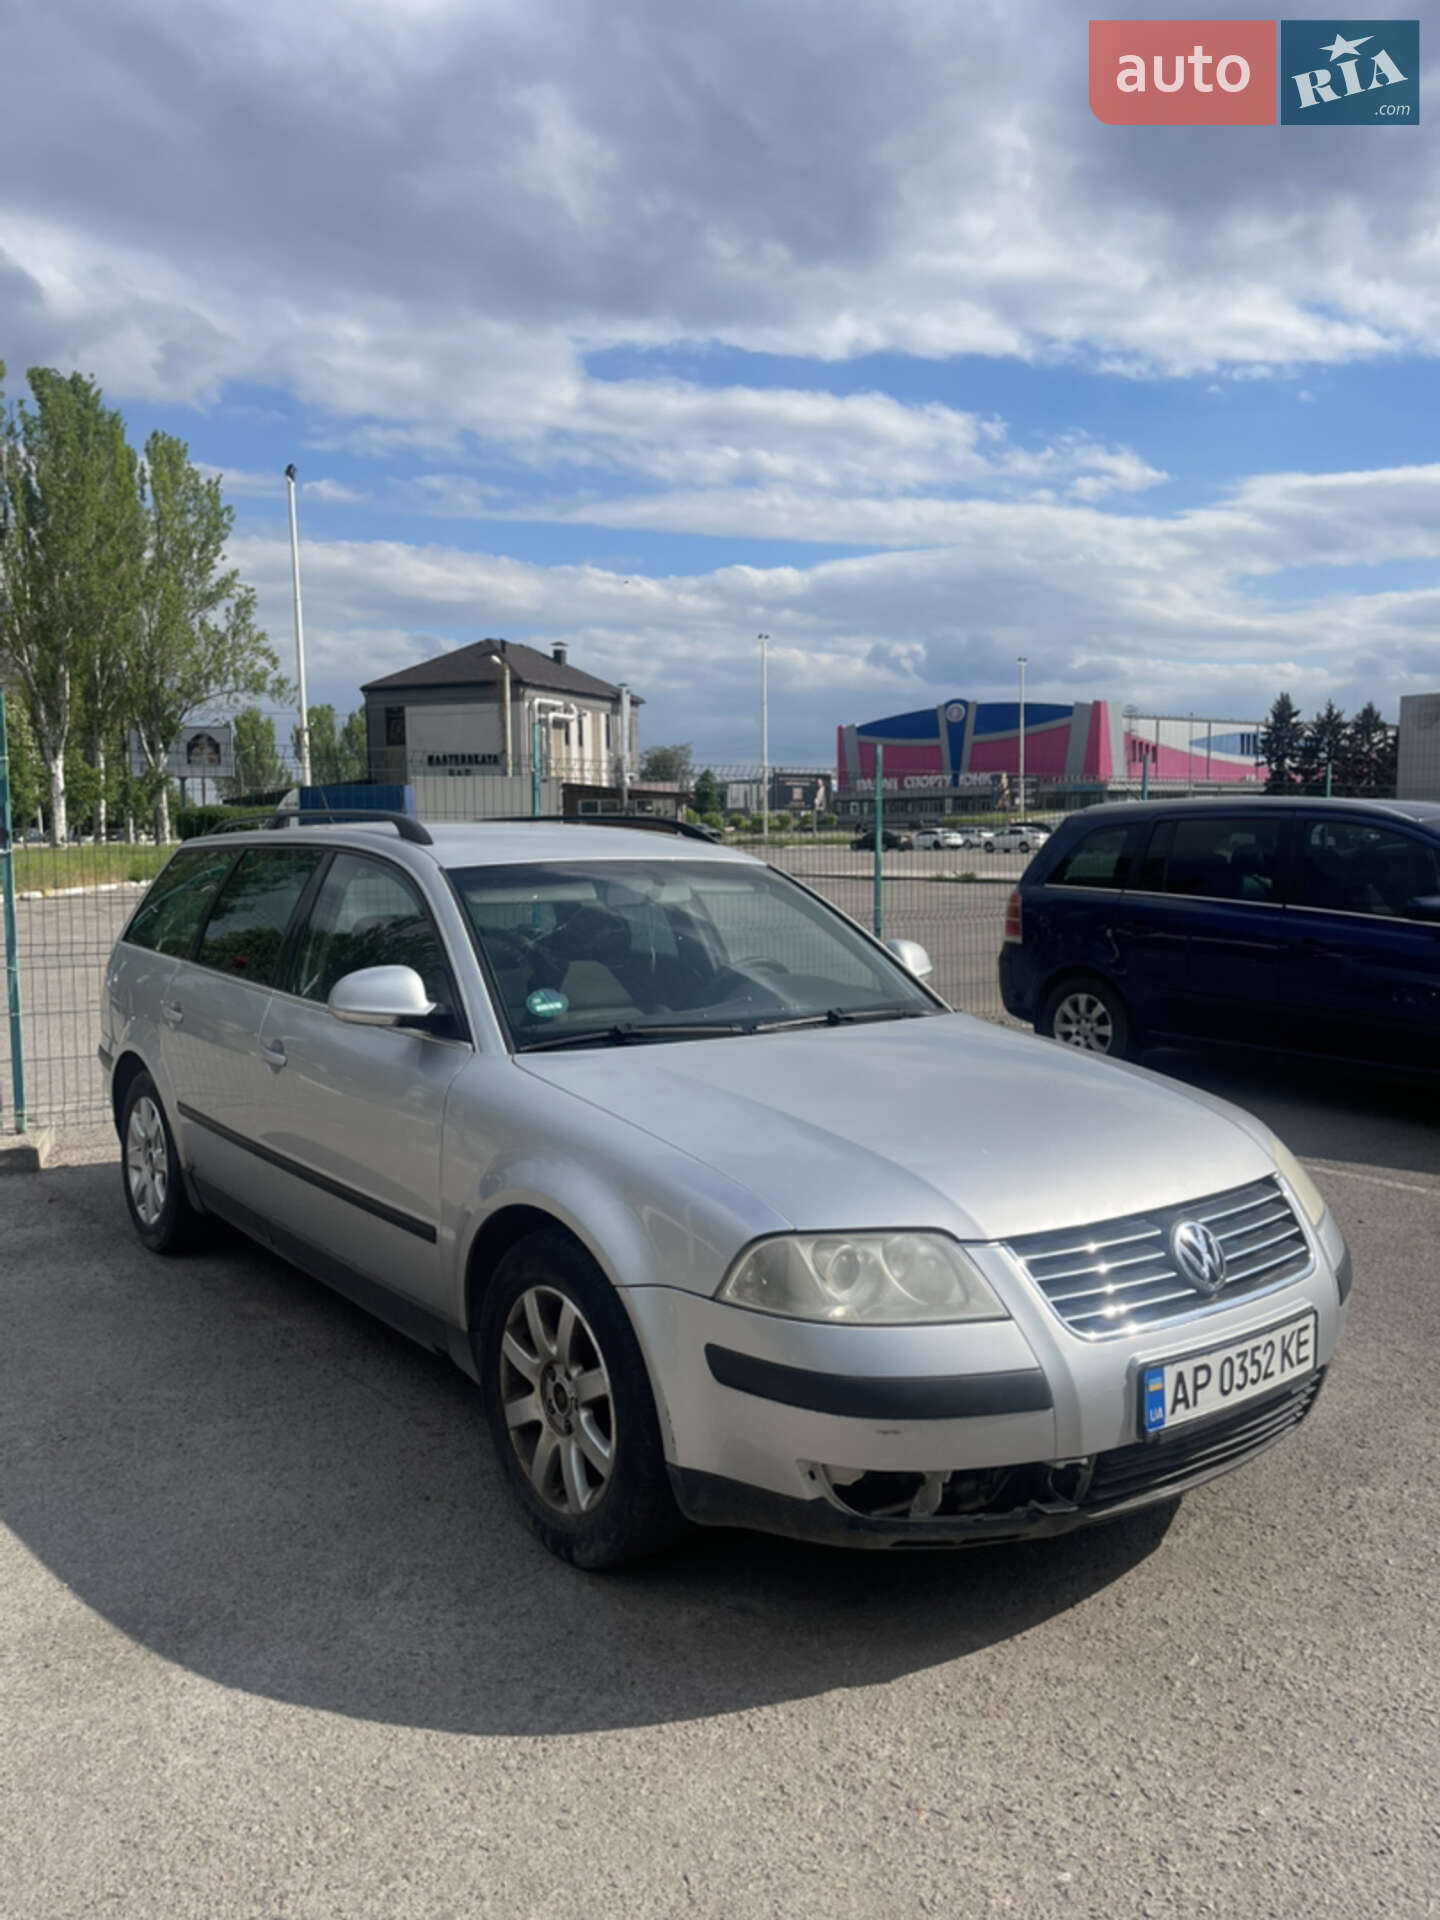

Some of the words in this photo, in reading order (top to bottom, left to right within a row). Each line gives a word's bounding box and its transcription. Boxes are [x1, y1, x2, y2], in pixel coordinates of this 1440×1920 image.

[1169, 1363, 1212, 1416] AP
[1219, 1340, 1276, 1397] 0352
[1281, 1324, 1311, 1373] KE
[1149, 1406, 1164, 1422] UA
